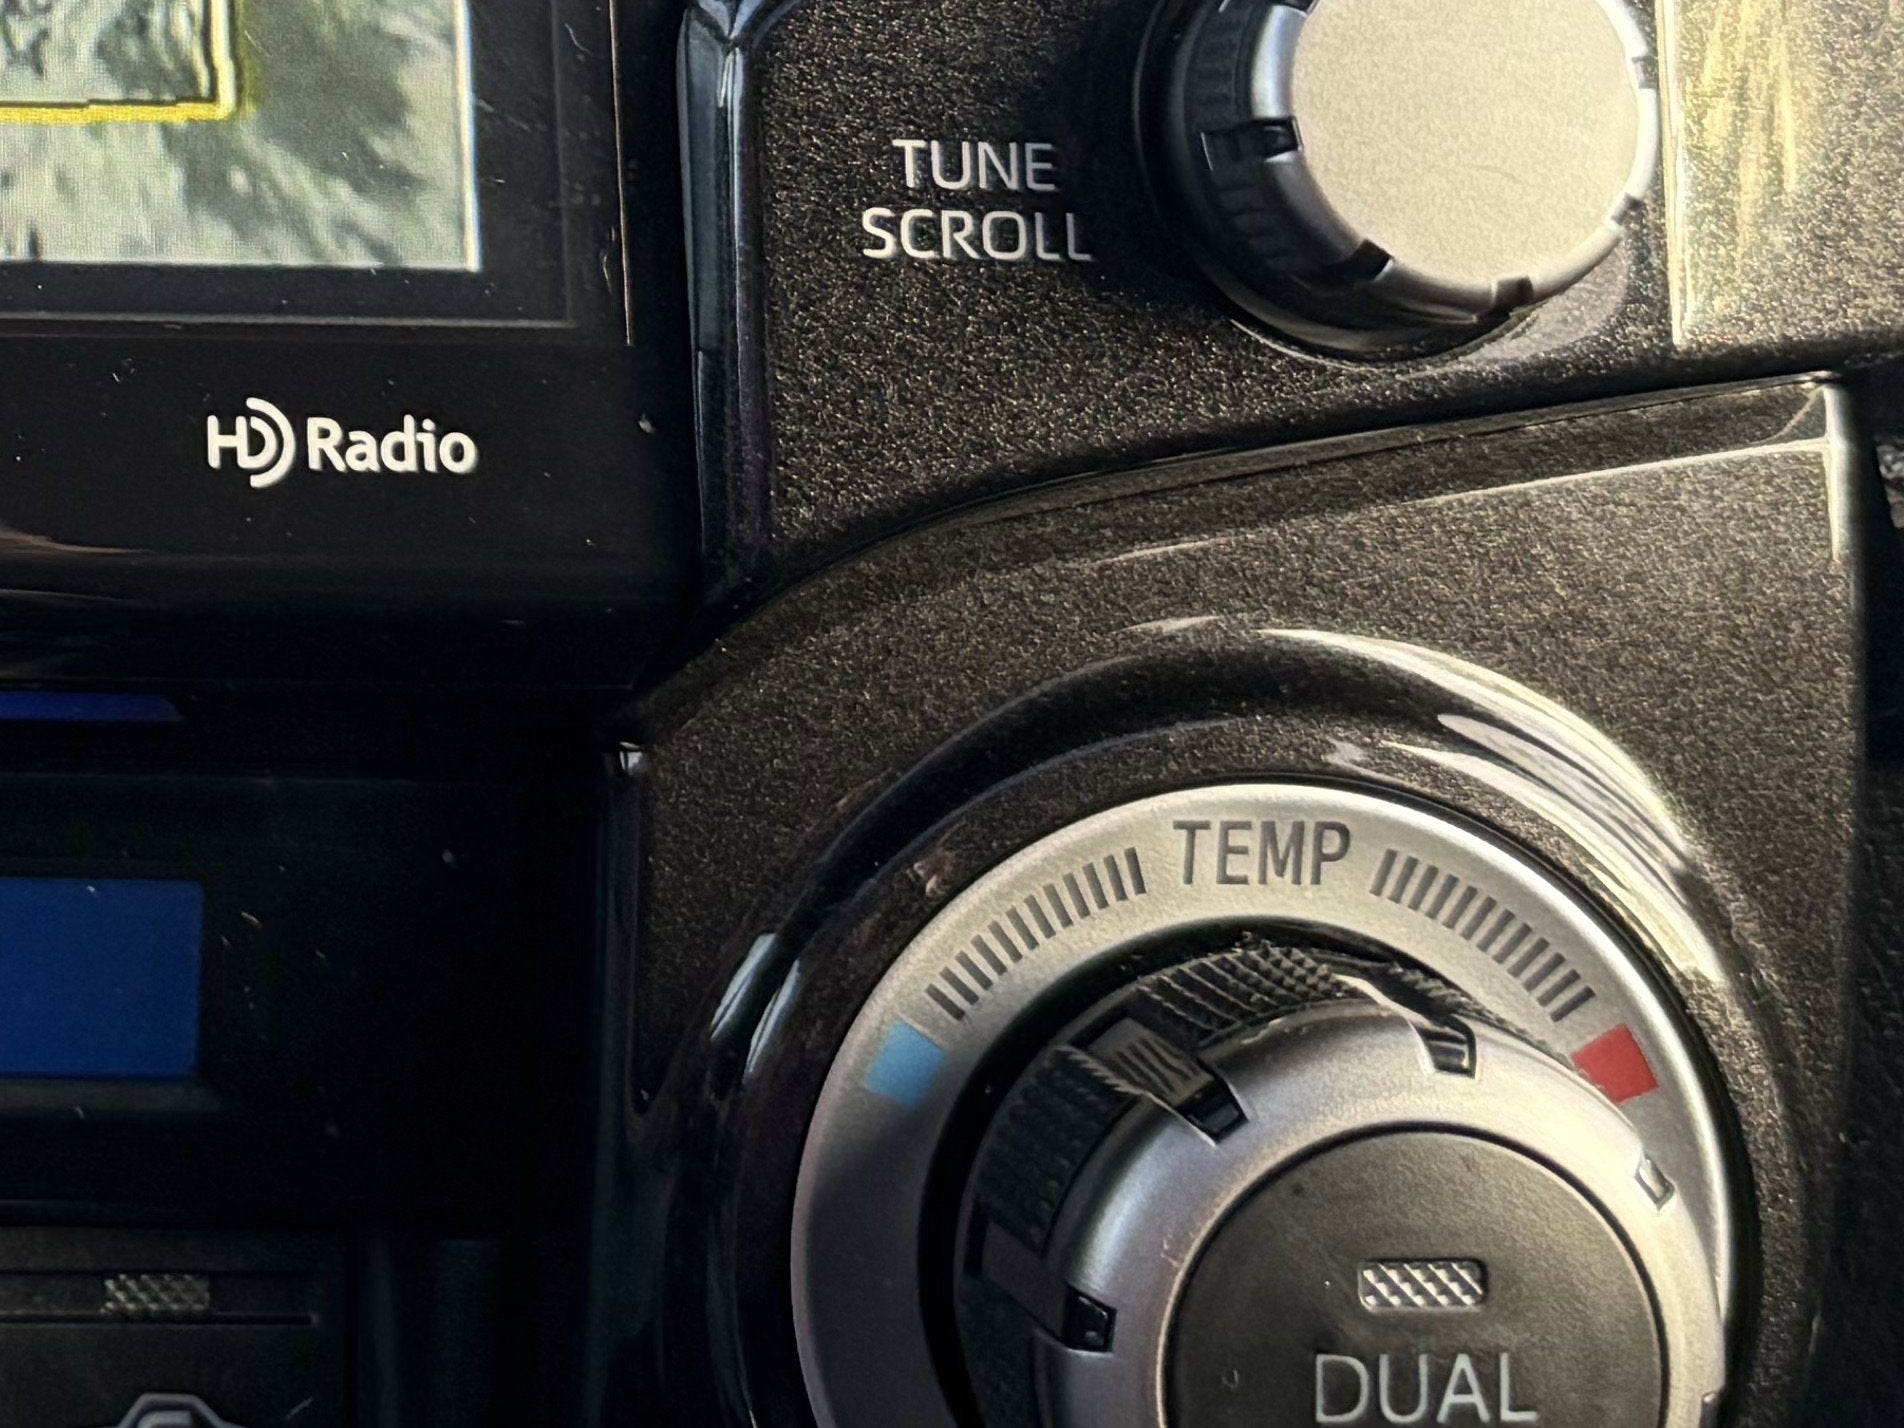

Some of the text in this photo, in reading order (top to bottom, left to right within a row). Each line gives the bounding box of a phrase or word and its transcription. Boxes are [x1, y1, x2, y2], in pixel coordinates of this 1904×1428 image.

[891, 137, 1059, 193] TUNE
[861, 206, 1094, 262] SCROLL
[206, 396, 480, 489] HD Radio
[1172, 819, 1352, 886] TEMP
[1314, 1351, 1541, 1426] DUAL
